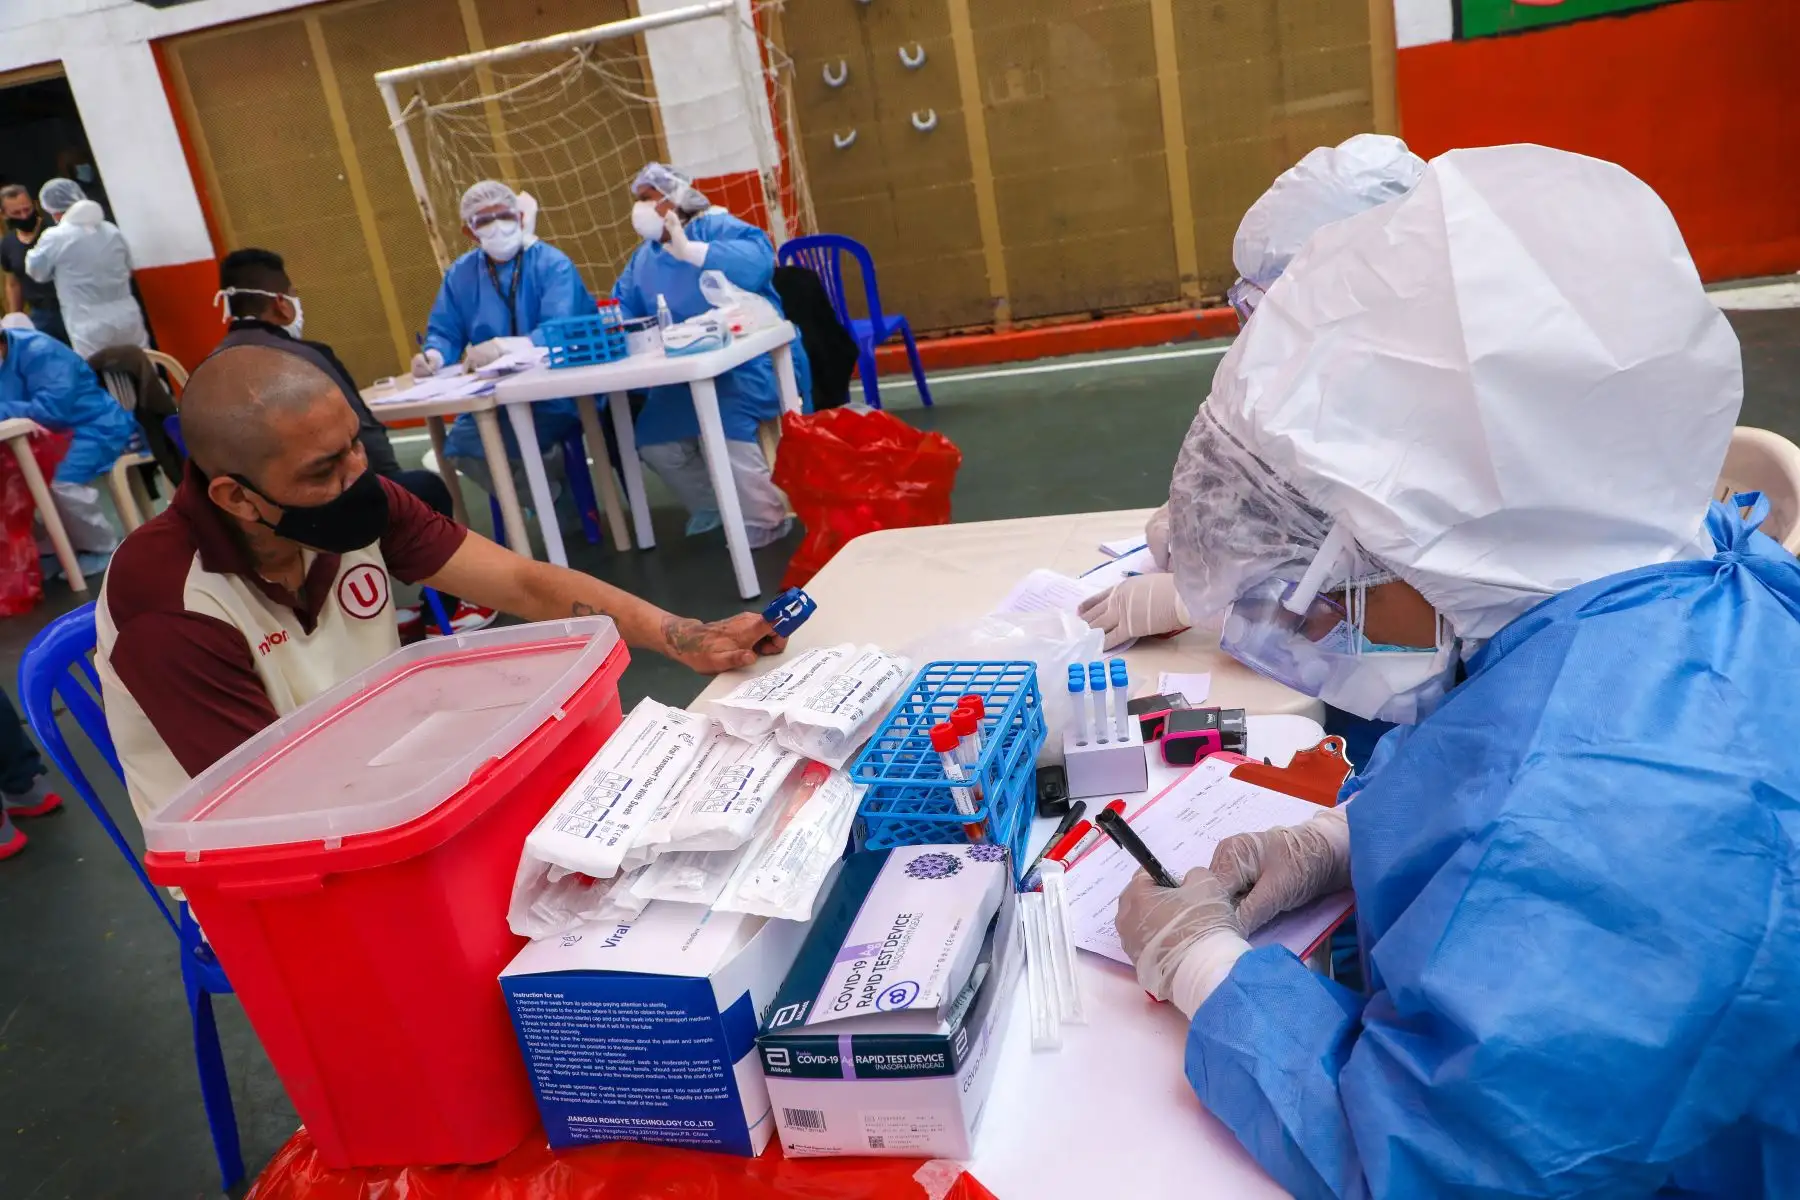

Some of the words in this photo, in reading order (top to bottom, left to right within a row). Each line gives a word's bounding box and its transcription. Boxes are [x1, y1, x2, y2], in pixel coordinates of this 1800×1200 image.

[348, 572, 378, 607] U
[668, 744, 681, 755] Viral
[652, 755, 674, 776] Transport
[643, 777, 657, 788] Tube
[635, 788, 648, 800] With
[600, 924, 631, 949] Viral
[856, 973, 883, 1008] RAPID
[872, 949, 894, 972] TEST
[884, 913, 912, 948] DEVICE
[834, 960, 867, 1011] COVID-19
[797, 1055, 838, 1064] COVID-19
[855, 1055, 885, 1064] RAPID
[885, 1054, 908, 1064] TEST
[909, 1053, 945, 1063] DEVICE
[875, 1062, 945, 1070] (NASOPHARYNGEAL)
[566, 1115, 597, 1123] JIANGSU
[598, 1116, 630, 1124] RONGYE
[630, 1117, 681, 1125] TECHNOLOGY
